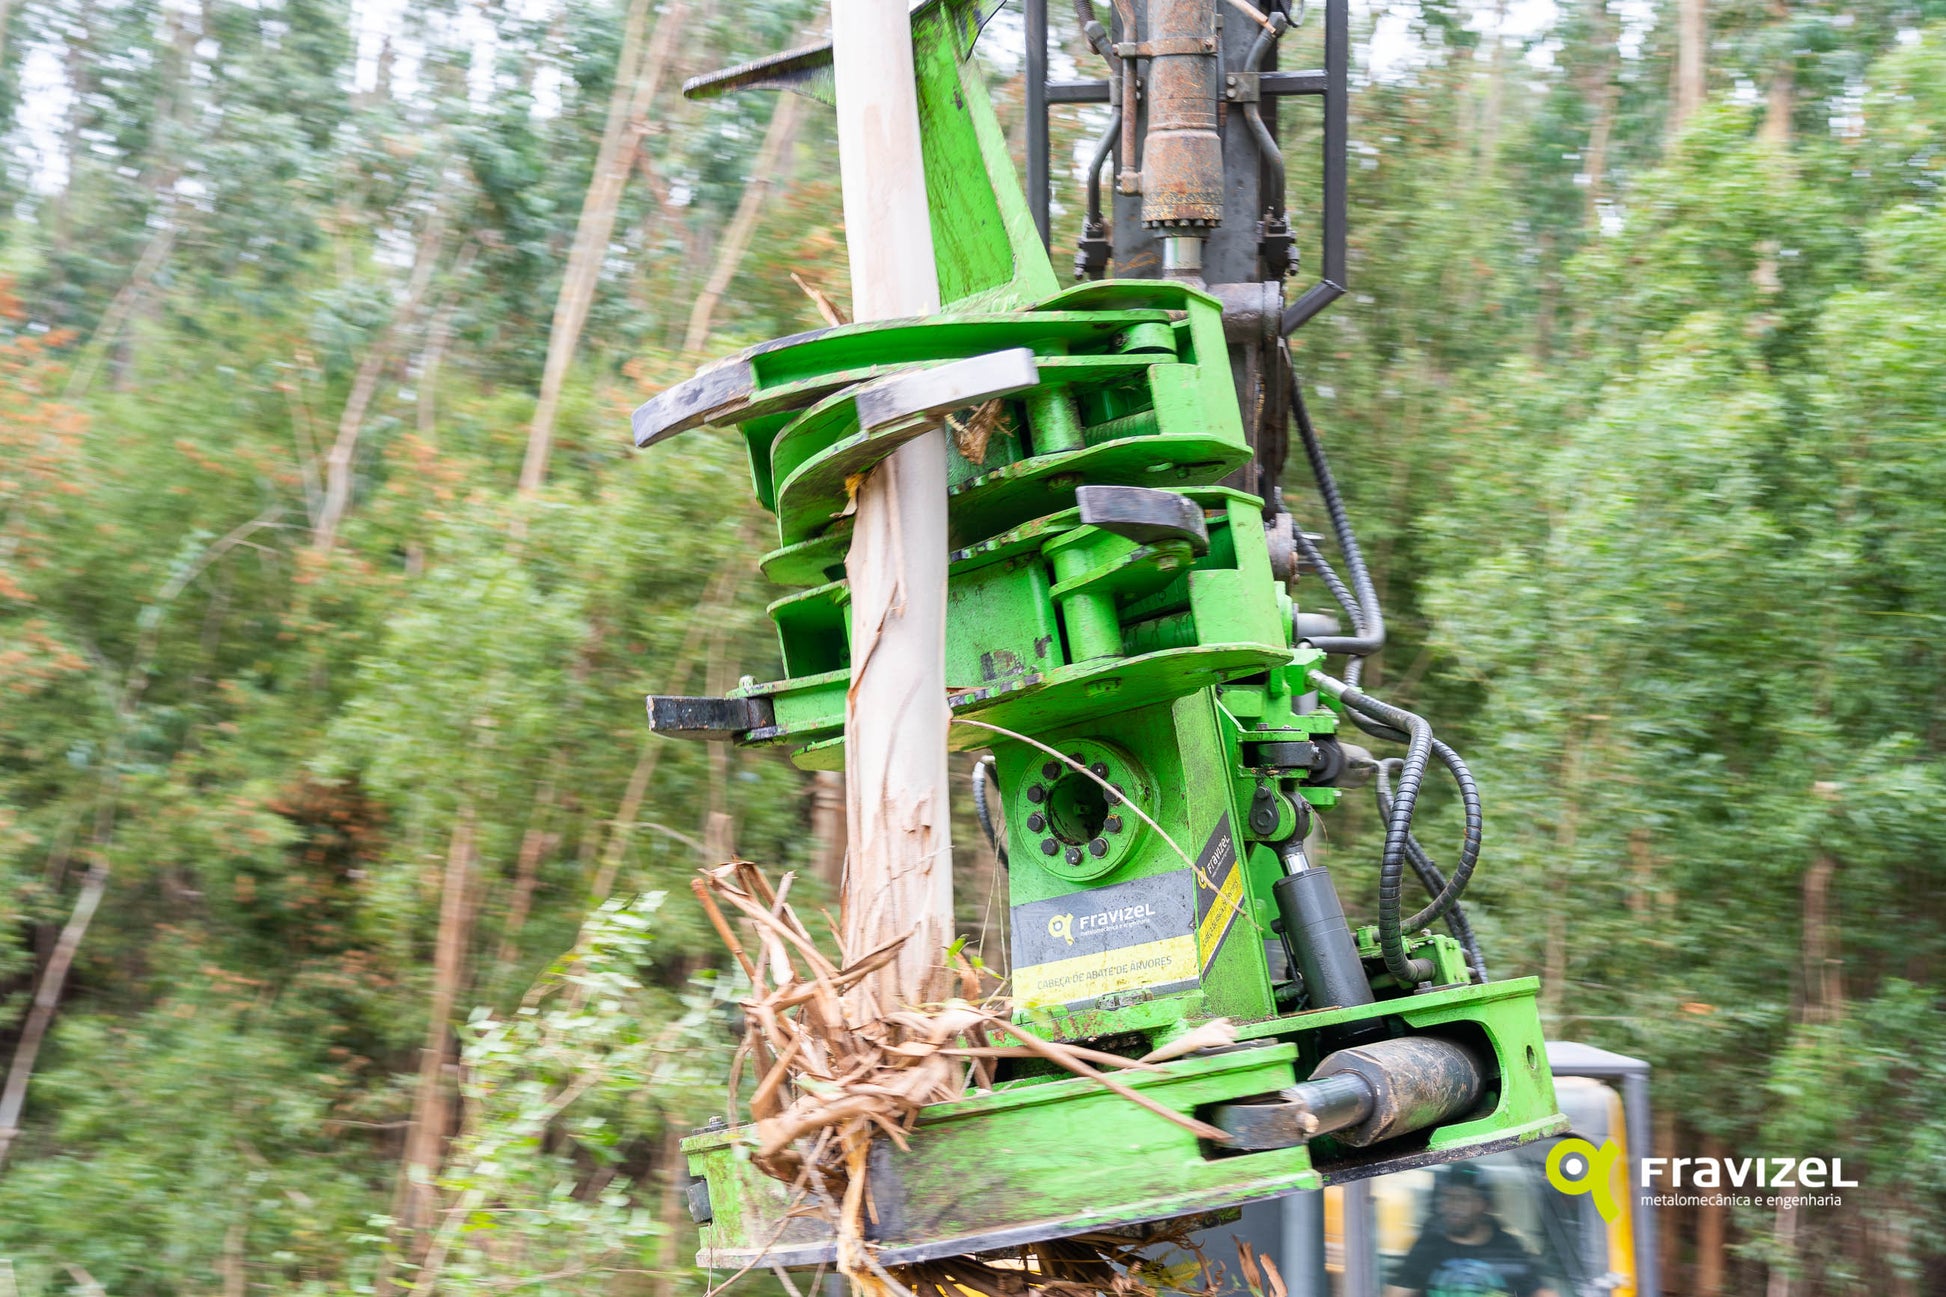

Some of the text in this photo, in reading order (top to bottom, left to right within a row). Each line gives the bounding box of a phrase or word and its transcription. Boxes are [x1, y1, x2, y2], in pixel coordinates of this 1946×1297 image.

[1037, 974, 1071, 990] CABEÇA
[1072, 972, 1085, 983] DE
[1086, 966, 1114, 980] ABATE
[1115, 963, 1129, 974] DE
